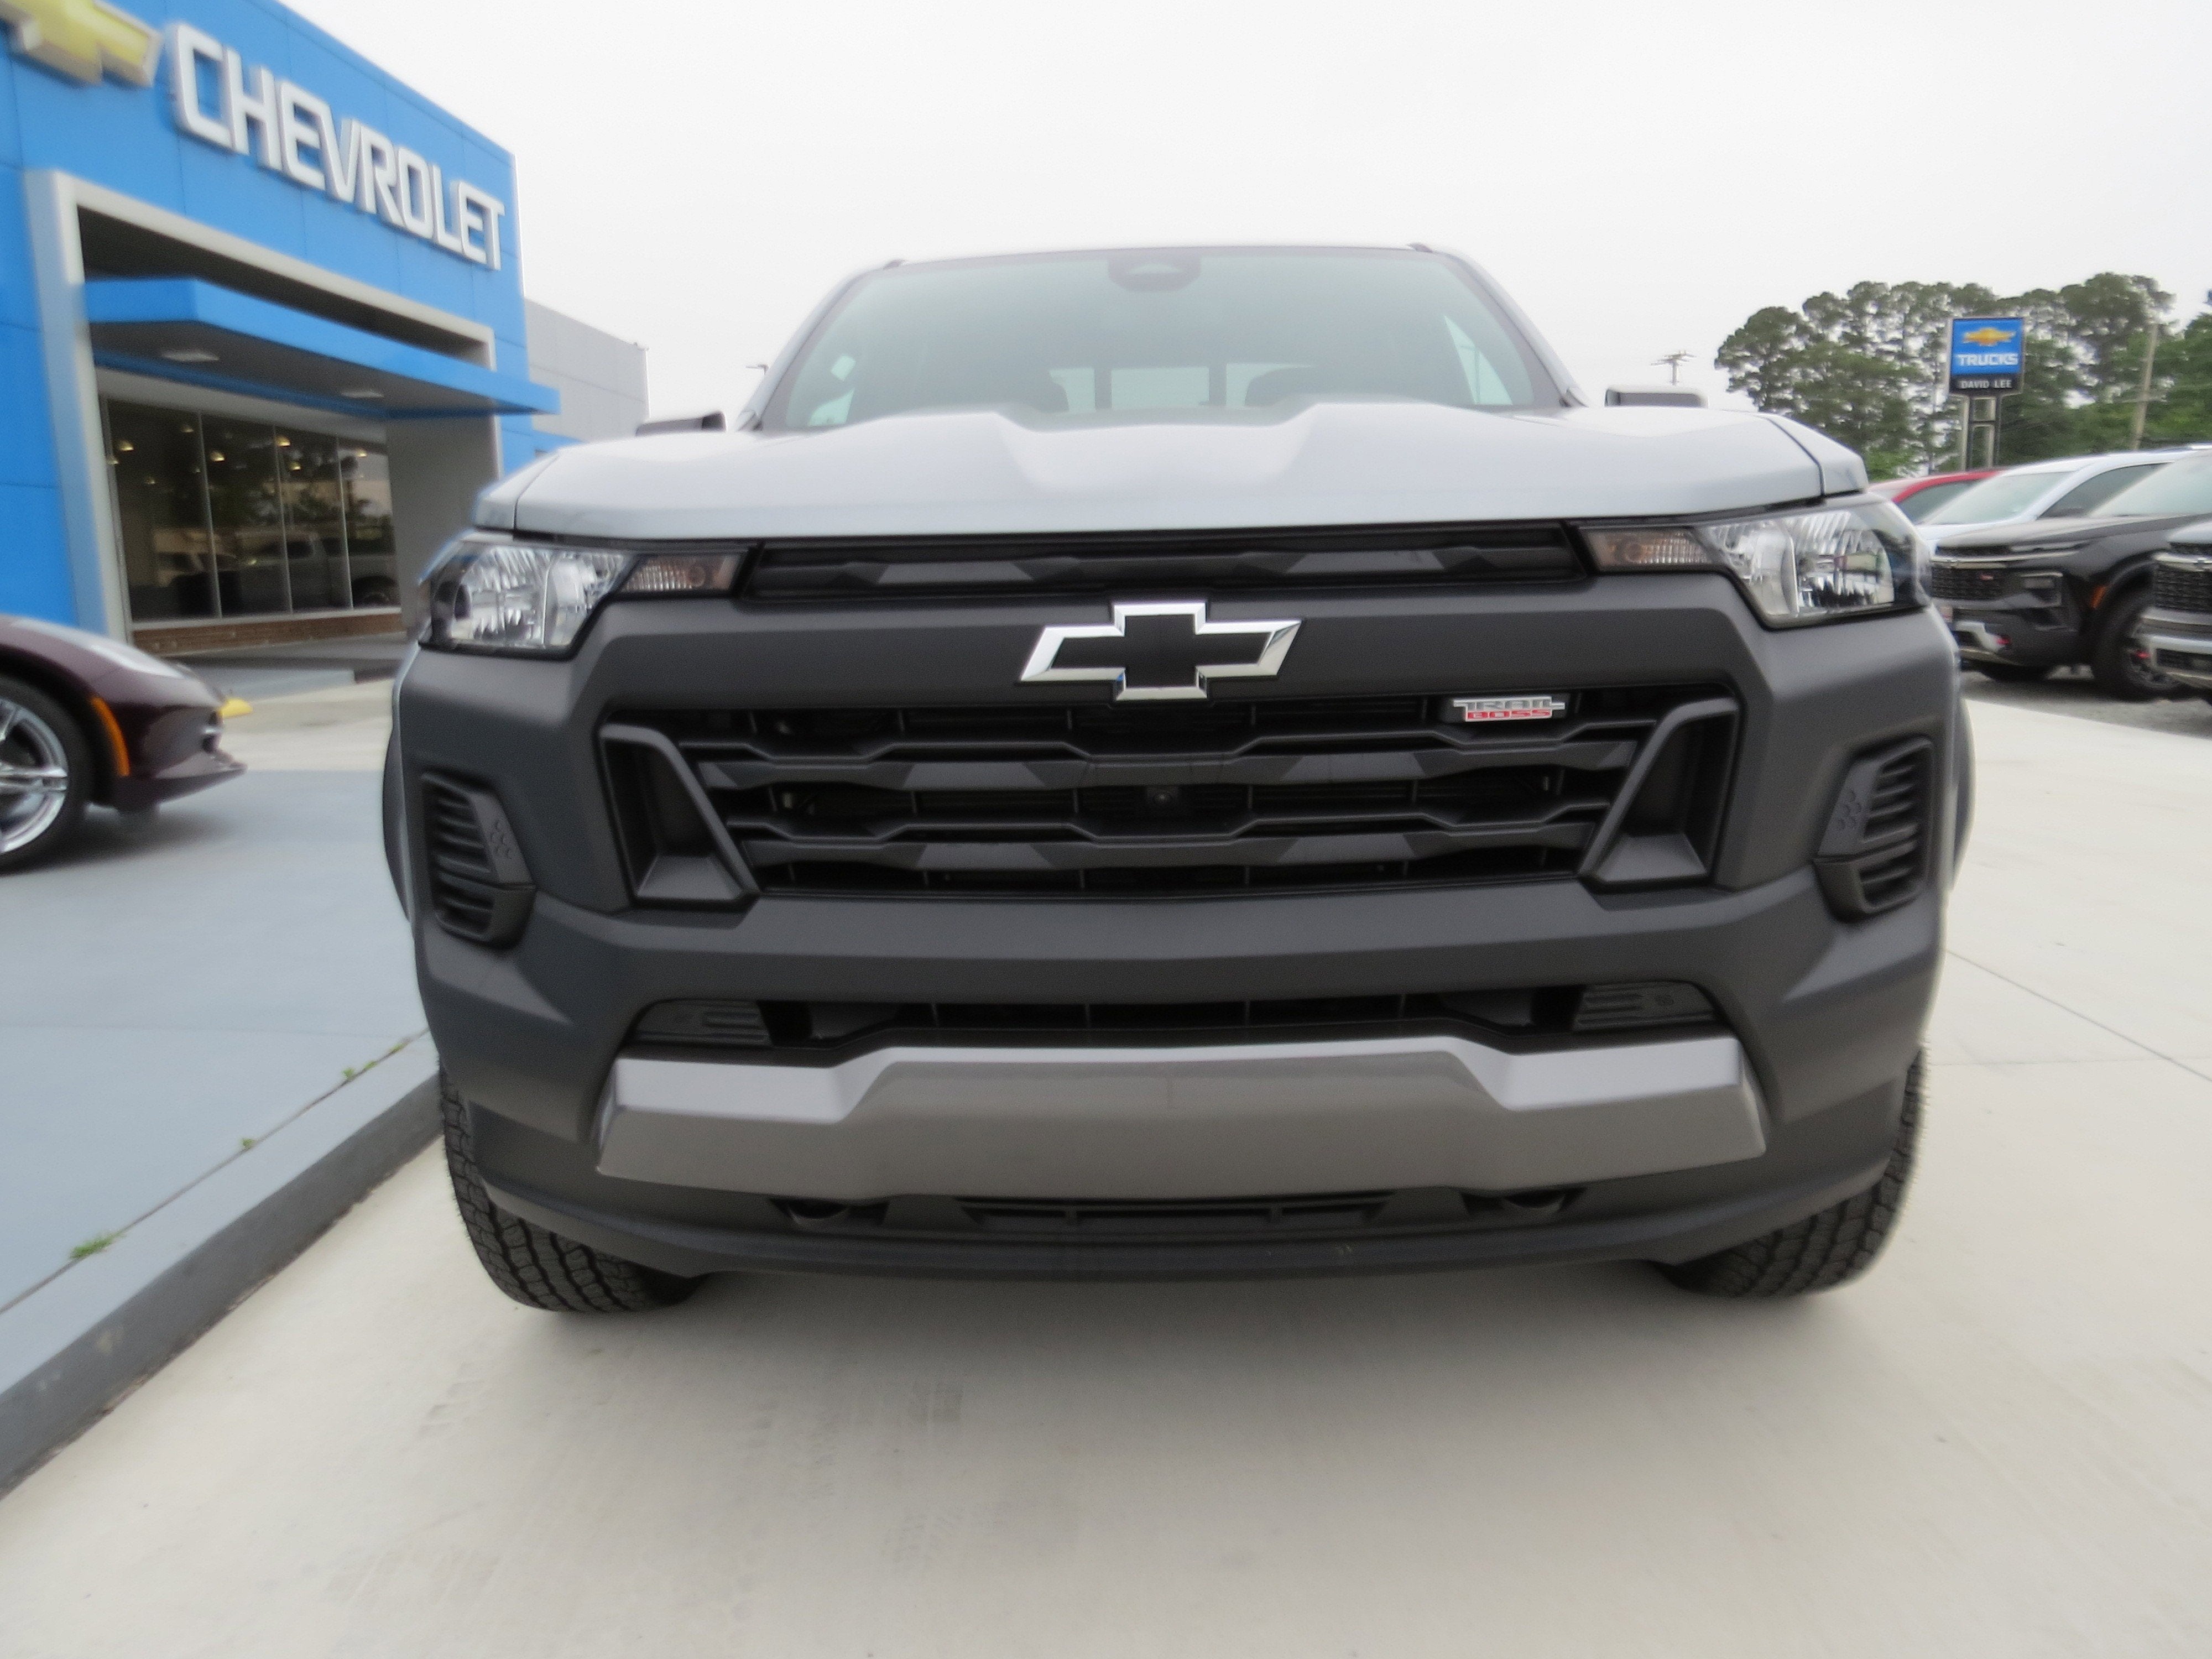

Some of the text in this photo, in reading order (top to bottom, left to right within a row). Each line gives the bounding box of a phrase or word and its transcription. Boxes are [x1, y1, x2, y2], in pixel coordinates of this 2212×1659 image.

[174, 23, 505, 270] CHEVROLET
[1958, 353, 2018, 366] TRUCKS
[1960, 379, 2012, 389] DAVID LEE
